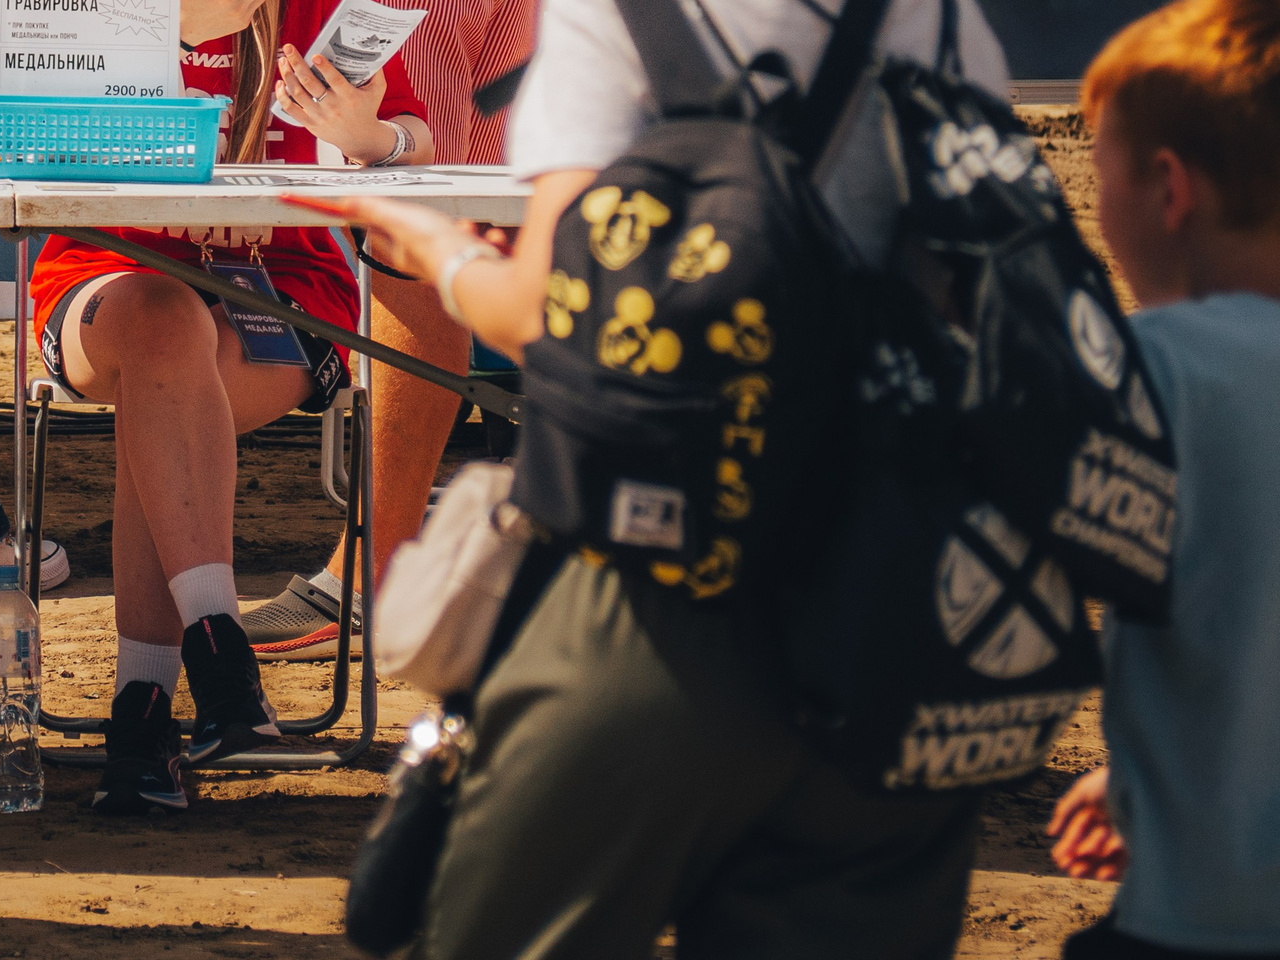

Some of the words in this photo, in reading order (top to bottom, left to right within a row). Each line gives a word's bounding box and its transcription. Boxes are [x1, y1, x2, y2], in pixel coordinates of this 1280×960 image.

[25, 22, 49, 30] ПОКУПКЕ
[11, 31, 49, 39] МЕДАЛЬНИЦЫ
[4, 52, 106, 73] МЕДАЛЬНИЦА
[104, 84, 136, 97] 2900
[140, 84, 164, 98] руб
[244, 324, 284, 334] МЕДАЛЕЙ
